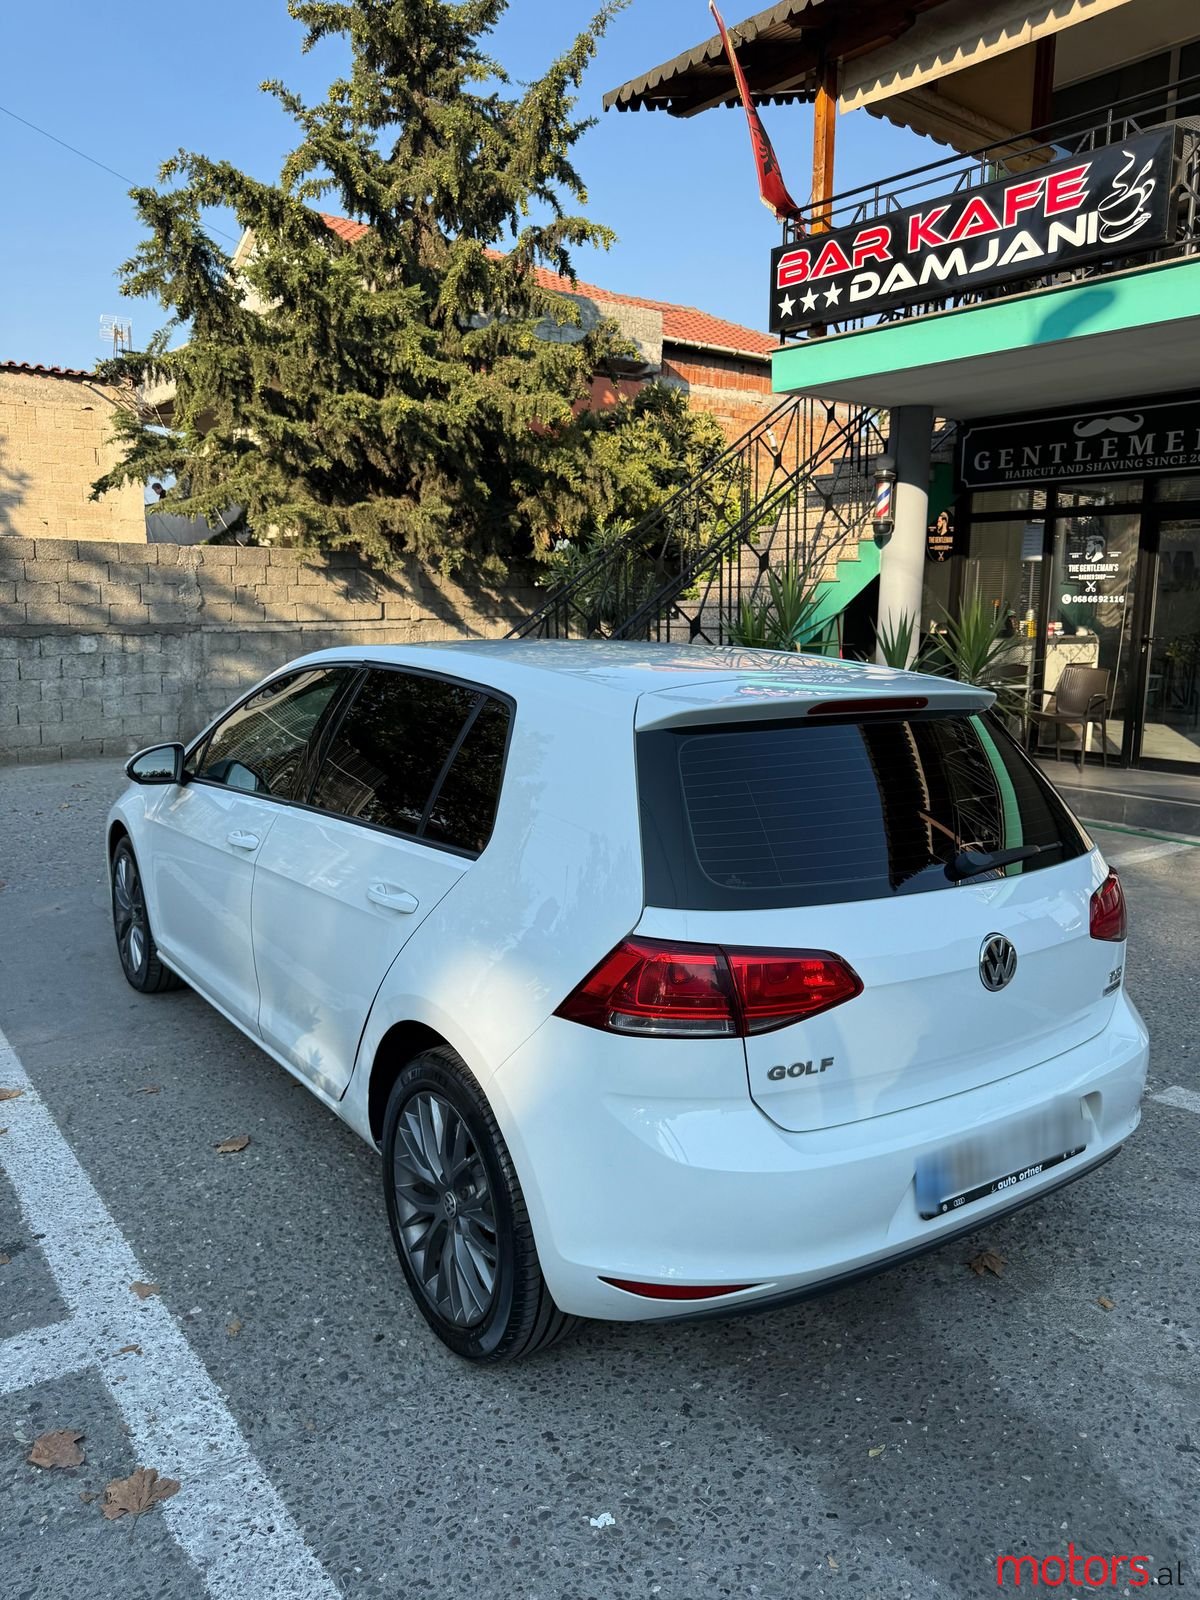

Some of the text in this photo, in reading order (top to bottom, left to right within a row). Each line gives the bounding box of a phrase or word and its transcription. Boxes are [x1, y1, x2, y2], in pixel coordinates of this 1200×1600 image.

[776, 161, 1094, 289] BAR KAFE
[849, 210, 1098, 302] DAMJANI
[1005, 466, 1056, 480] HAIRCUT
[1058, 464, 1084, 475] AND
[1086, 458, 1143, 473] SHAVING
[1146, 454, 1187, 467] SINCE
[1068, 564, 1080, 573] THE
[767, 1056, 834, 1081] GOLF
[997, 1175, 1017, 1190] auto
